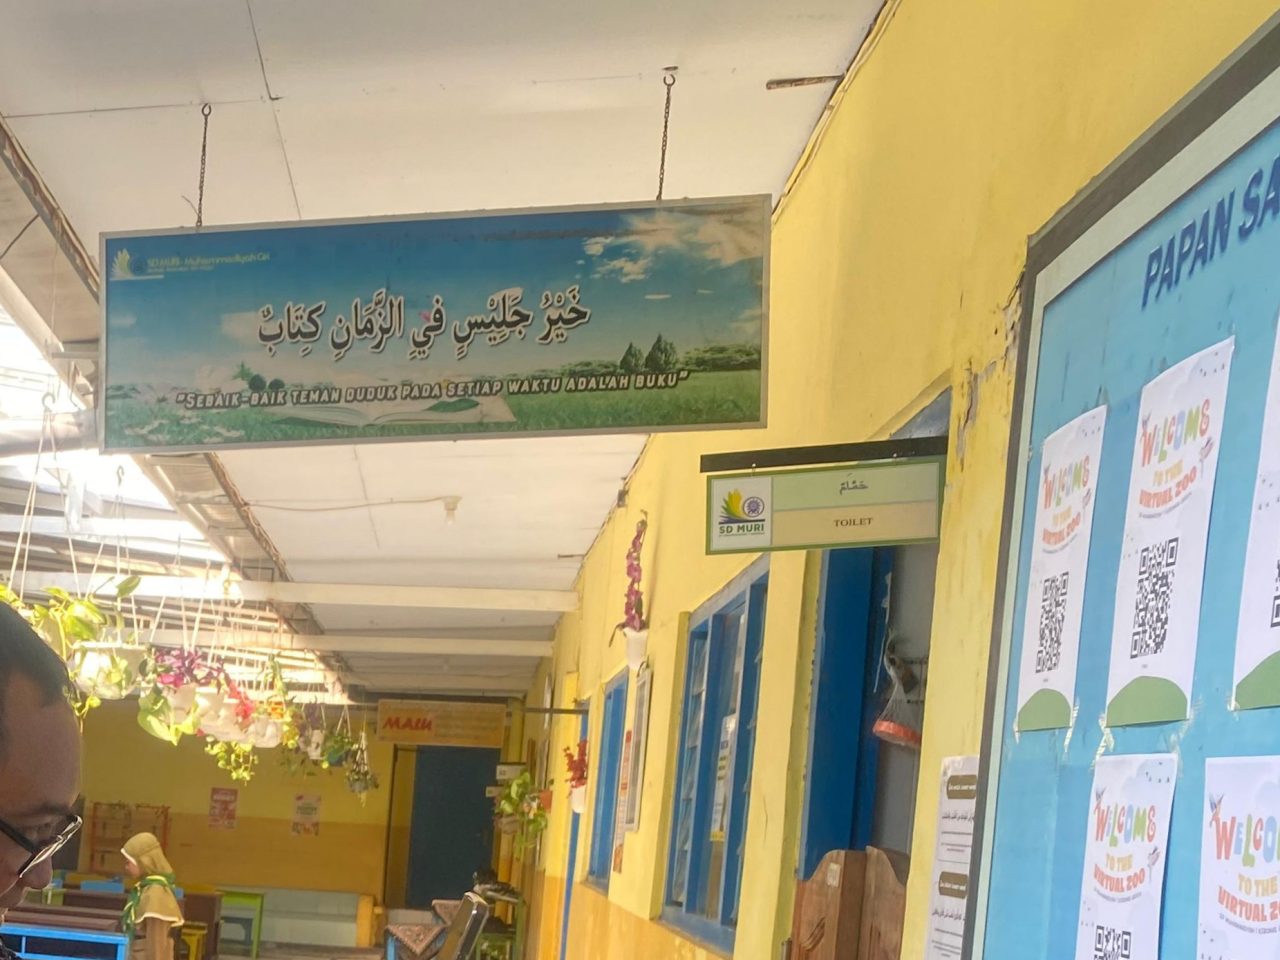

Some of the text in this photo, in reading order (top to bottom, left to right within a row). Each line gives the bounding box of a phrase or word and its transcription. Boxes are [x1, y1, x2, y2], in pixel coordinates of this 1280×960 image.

[1141, 188, 1236, 311] PAPAN
[290, 387, 341, 406] TEMAN
[344, 385, 397, 403] DUDUK
[400, 382, 442, 400] PADA
[446, 379, 503, 398] SETIAP
[508, 377, 562, 396] WAKTU
[565, 374, 629, 393] ADALAH
[719, 523, 764, 534] SD MURI
[833, 516, 874, 529] TOILET
[1094, 801, 1156, 848] WELCOME
[1094, 863, 1146, 893] VIRTUAL ZOO
[1237, 873, 1278, 897] TO THE
[1218, 886, 1267, 922] VIRTUAL
